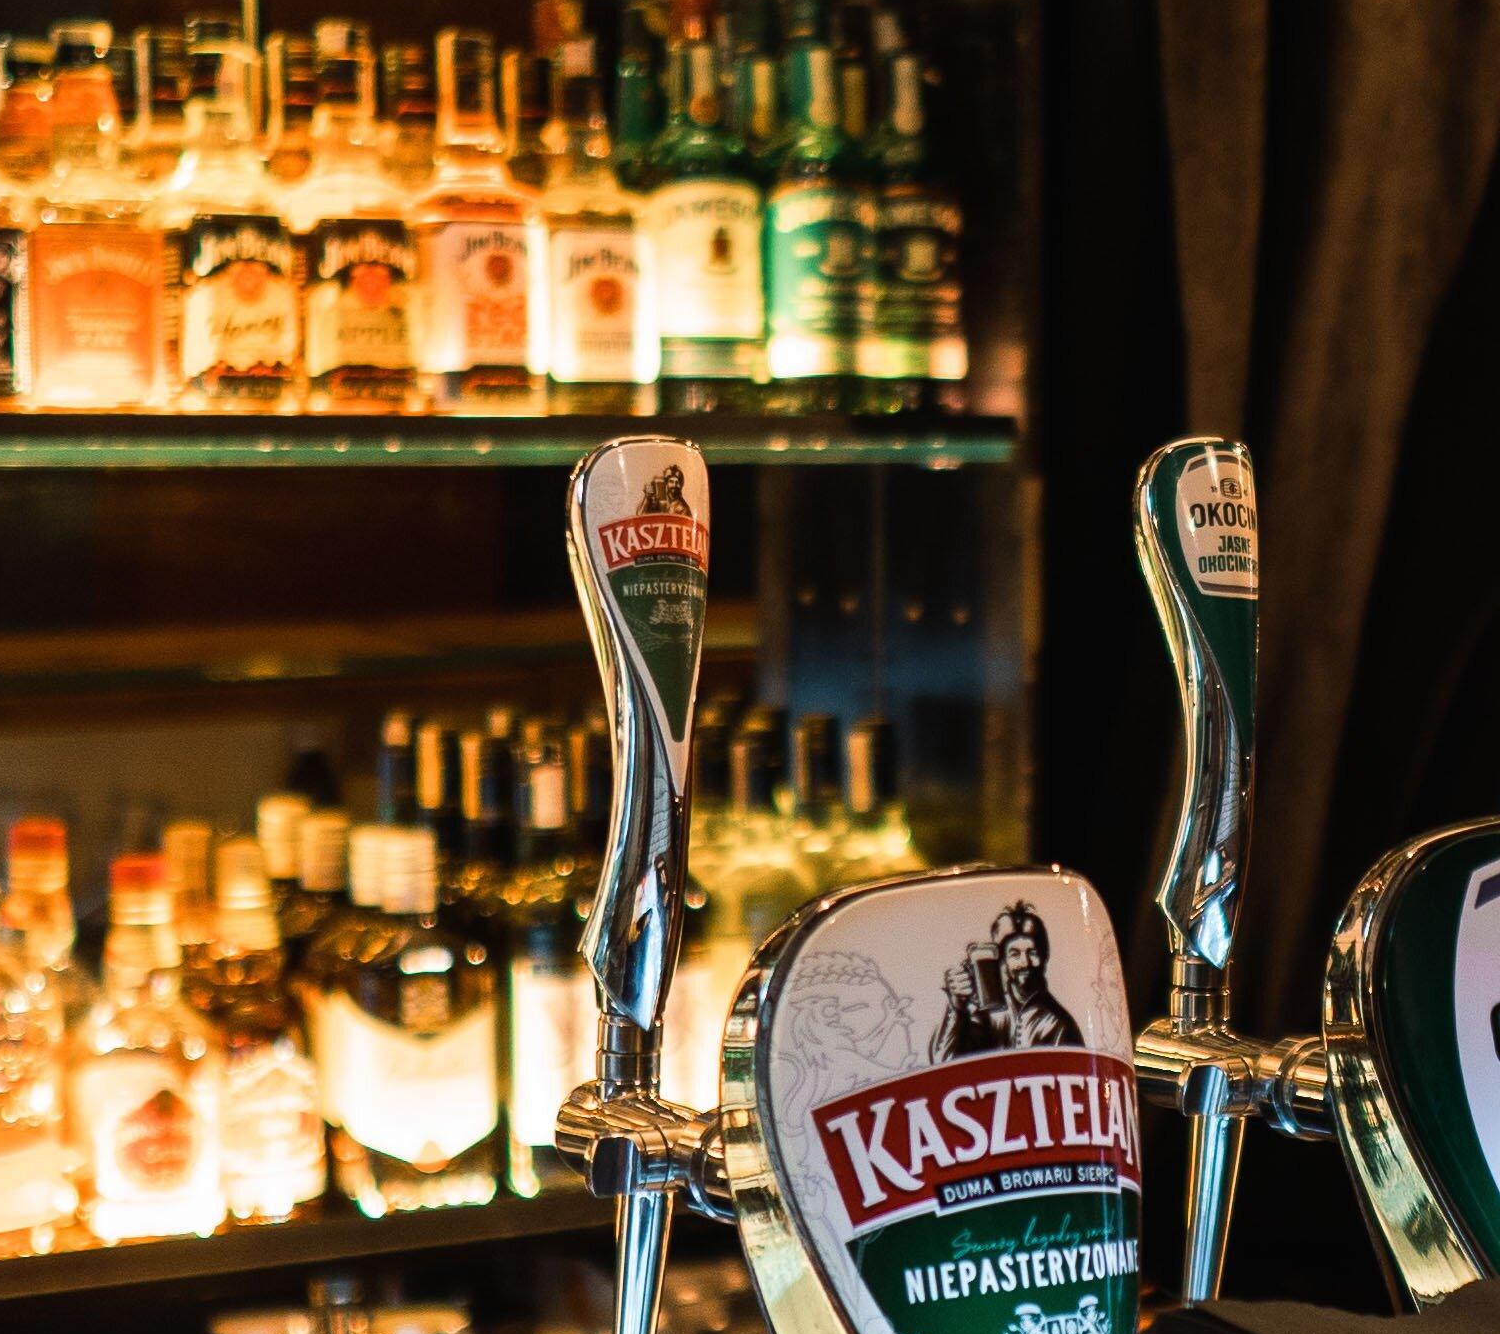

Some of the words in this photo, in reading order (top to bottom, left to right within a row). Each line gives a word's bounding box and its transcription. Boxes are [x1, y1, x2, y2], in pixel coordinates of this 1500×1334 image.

[602, 522, 708, 563] KASZTELAN
[828, 1074, 1142, 1208] KASZTELAN
[943, 1178, 995, 1204] DUMA
[1000, 1166, 1073, 1191] BROWARU
[905, 1238, 1139, 1305] NIEPASTERYZOWANE
